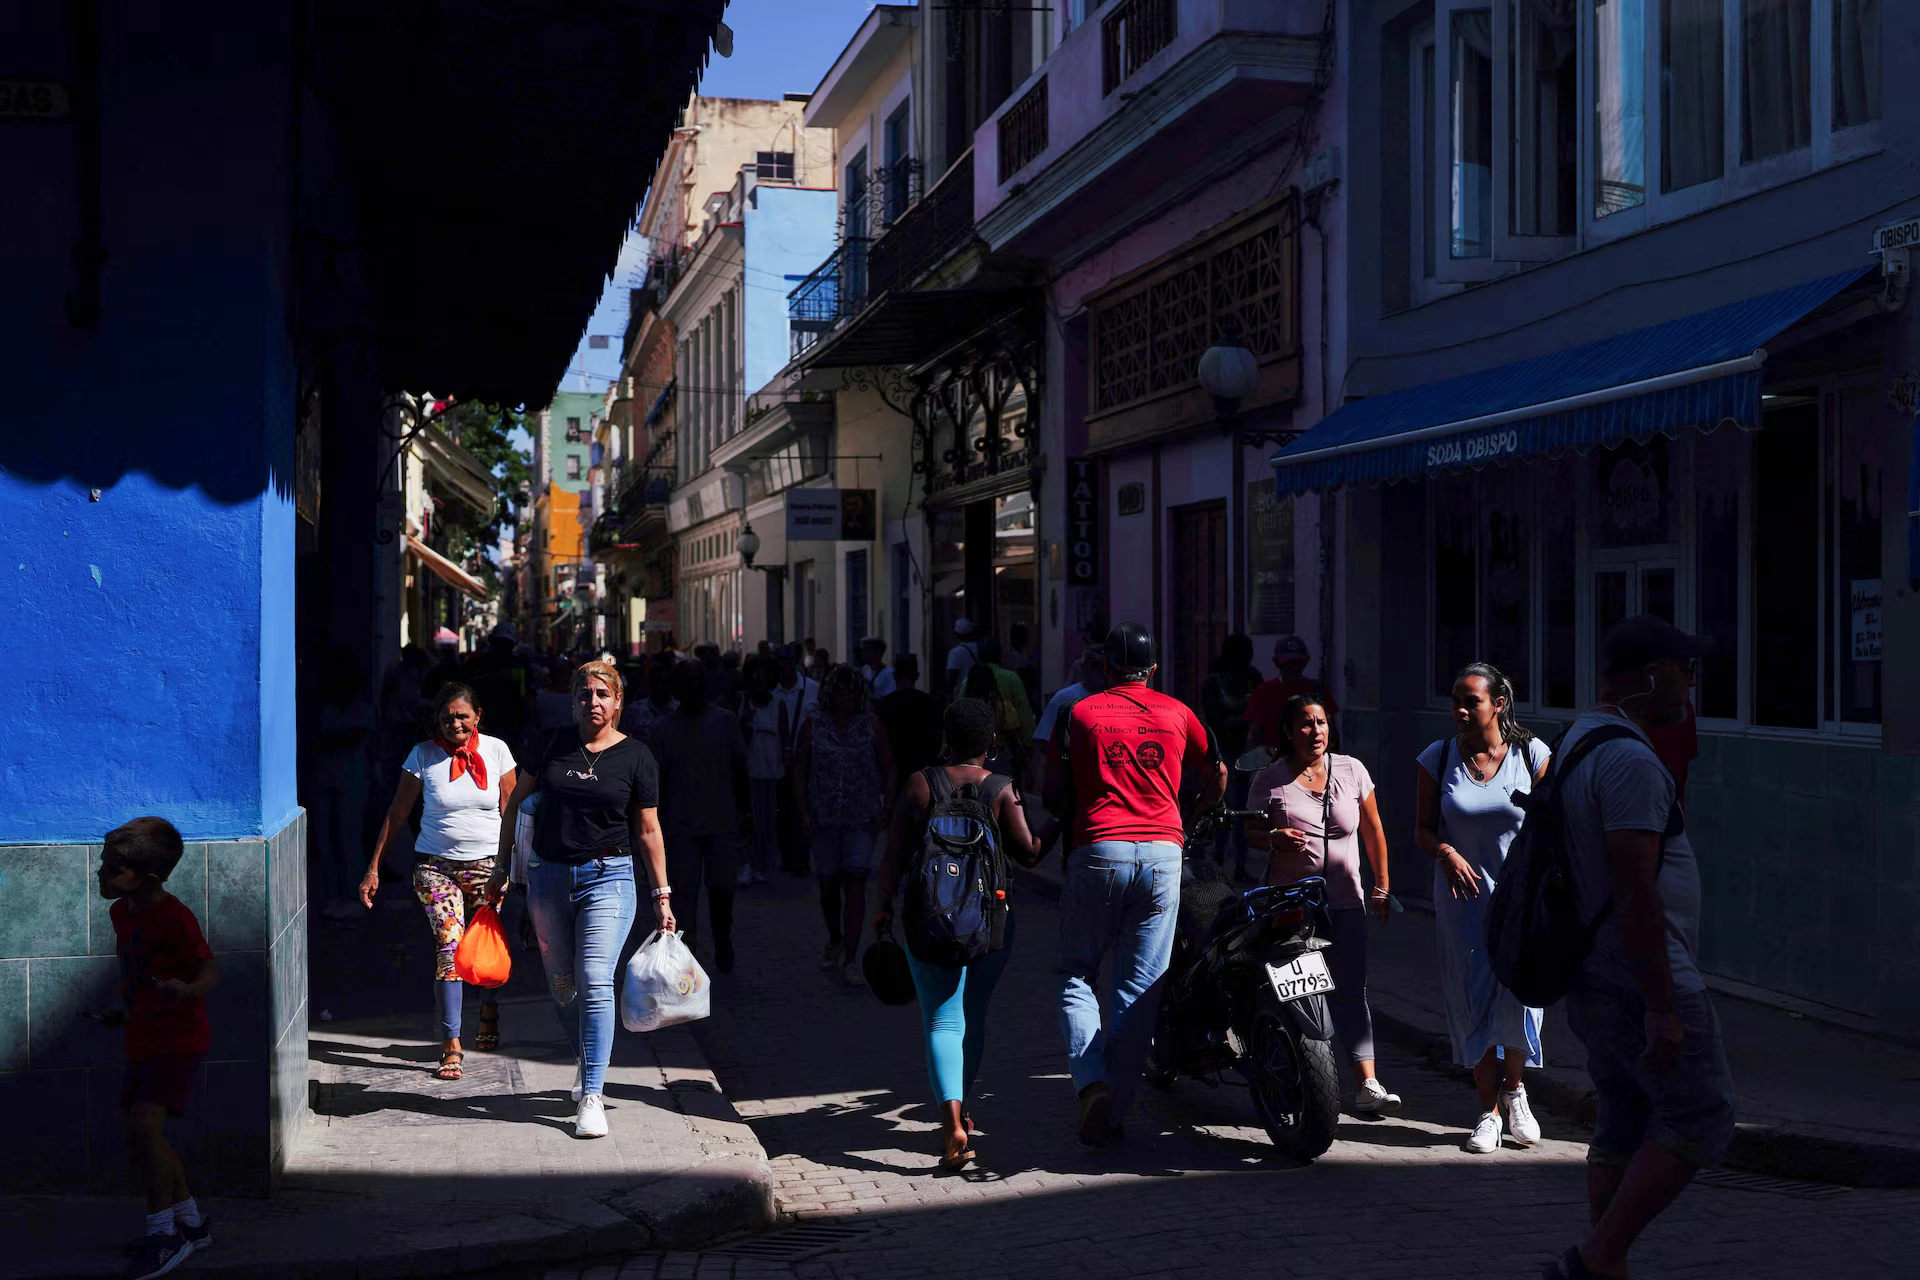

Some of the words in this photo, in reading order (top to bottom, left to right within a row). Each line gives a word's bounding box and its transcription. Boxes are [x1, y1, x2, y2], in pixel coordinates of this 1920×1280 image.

[1880, 222, 1919, 248] OBISPO
[1427, 442, 1461, 466] SODA
[1466, 430, 1518, 460] OBISPO
[1072, 460, 1095, 580] TATTOO
[1104, 726, 1133, 734] MERCY
[1291, 960, 1303, 975] U
[1278, 973, 1329, 998] 07795
